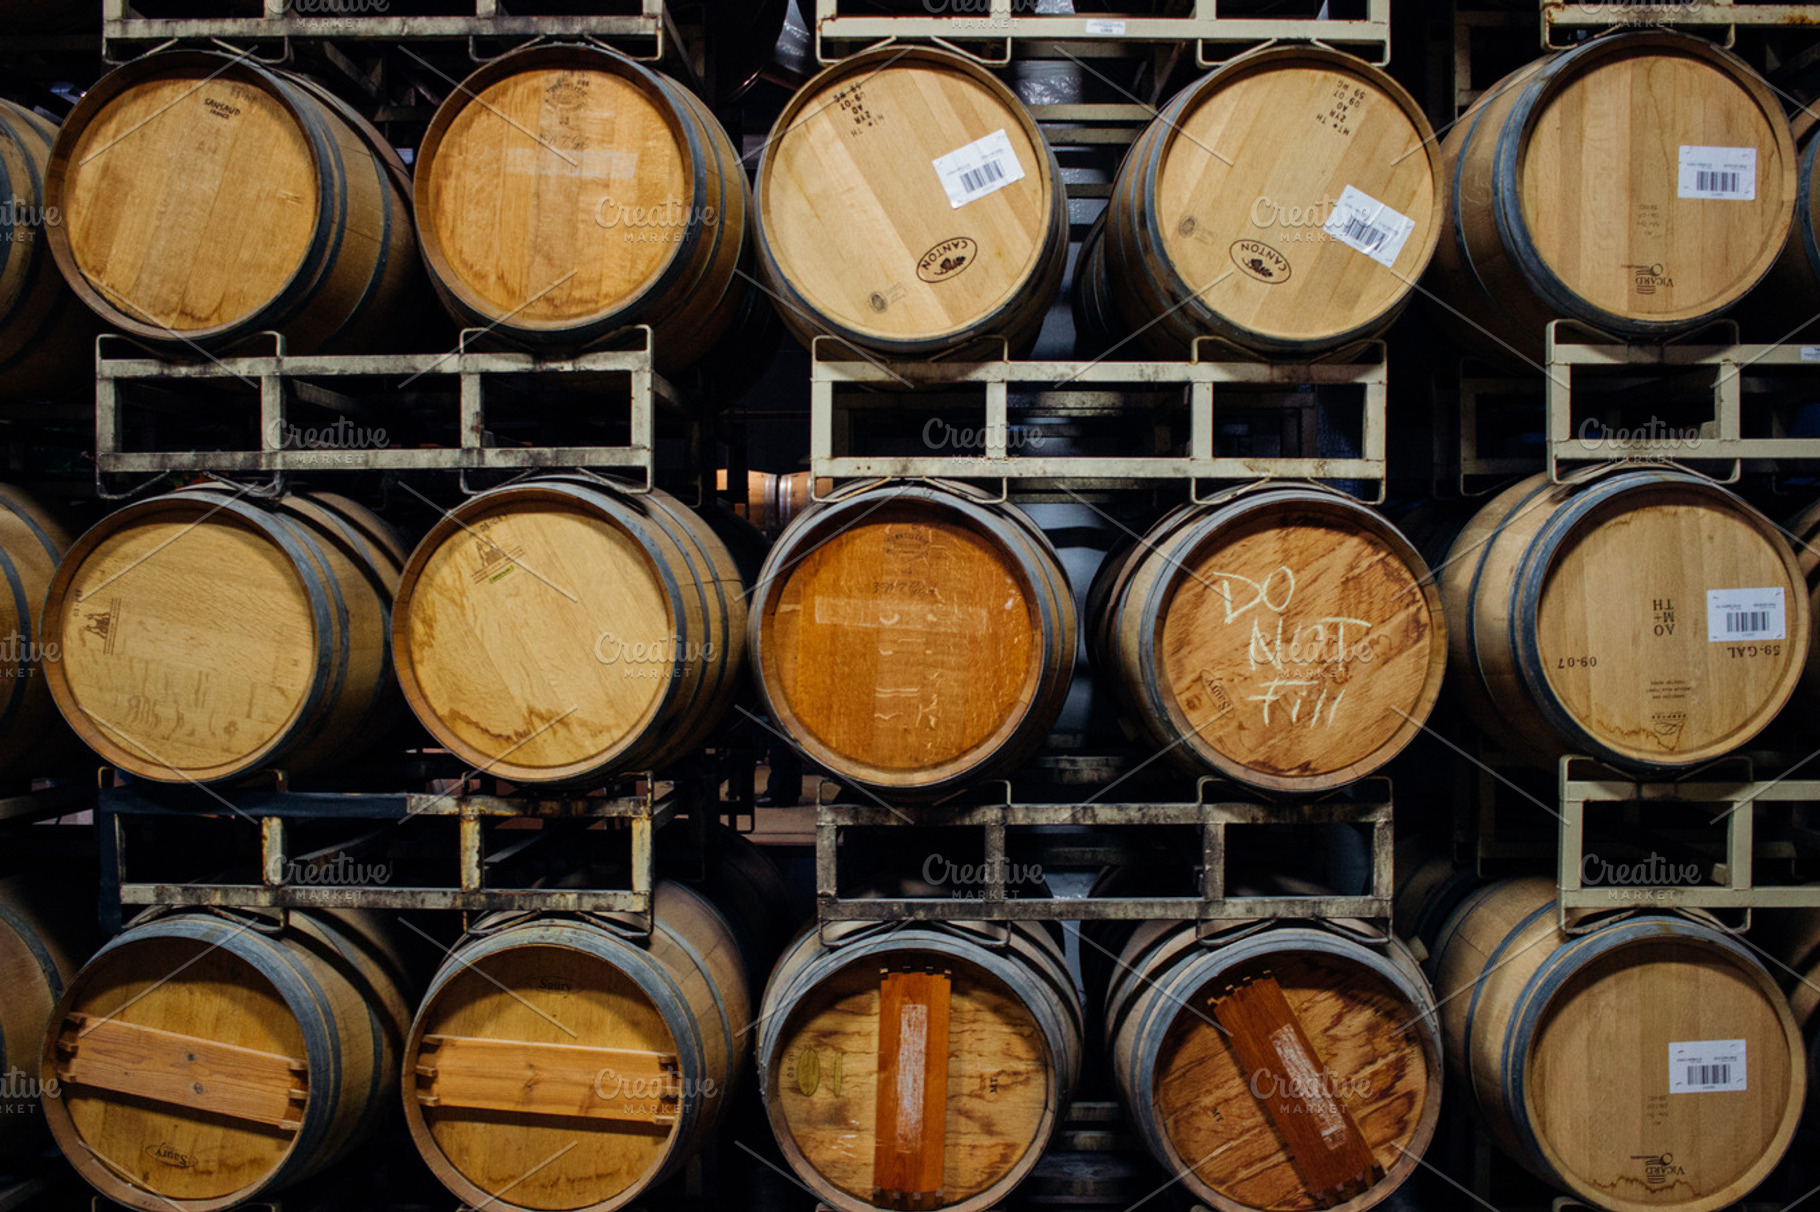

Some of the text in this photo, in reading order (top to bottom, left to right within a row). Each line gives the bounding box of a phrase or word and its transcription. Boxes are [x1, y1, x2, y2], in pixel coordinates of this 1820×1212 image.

[921, 240, 968, 270] CANTON
[1240, 243, 1287, 272] CANTON
[1635, 276, 1674, 288] VICARD
[1213, 566, 1294, 624] DO
[1652, 599, 1674, 611] TH
[1653, 611, 1675, 623] M+
[1653, 624, 1675, 637] AO
[1249, 616, 1371, 671] NOT
[155, 1142, 188, 1166] Saury
[1645, 1165, 1686, 1176] VICARD
